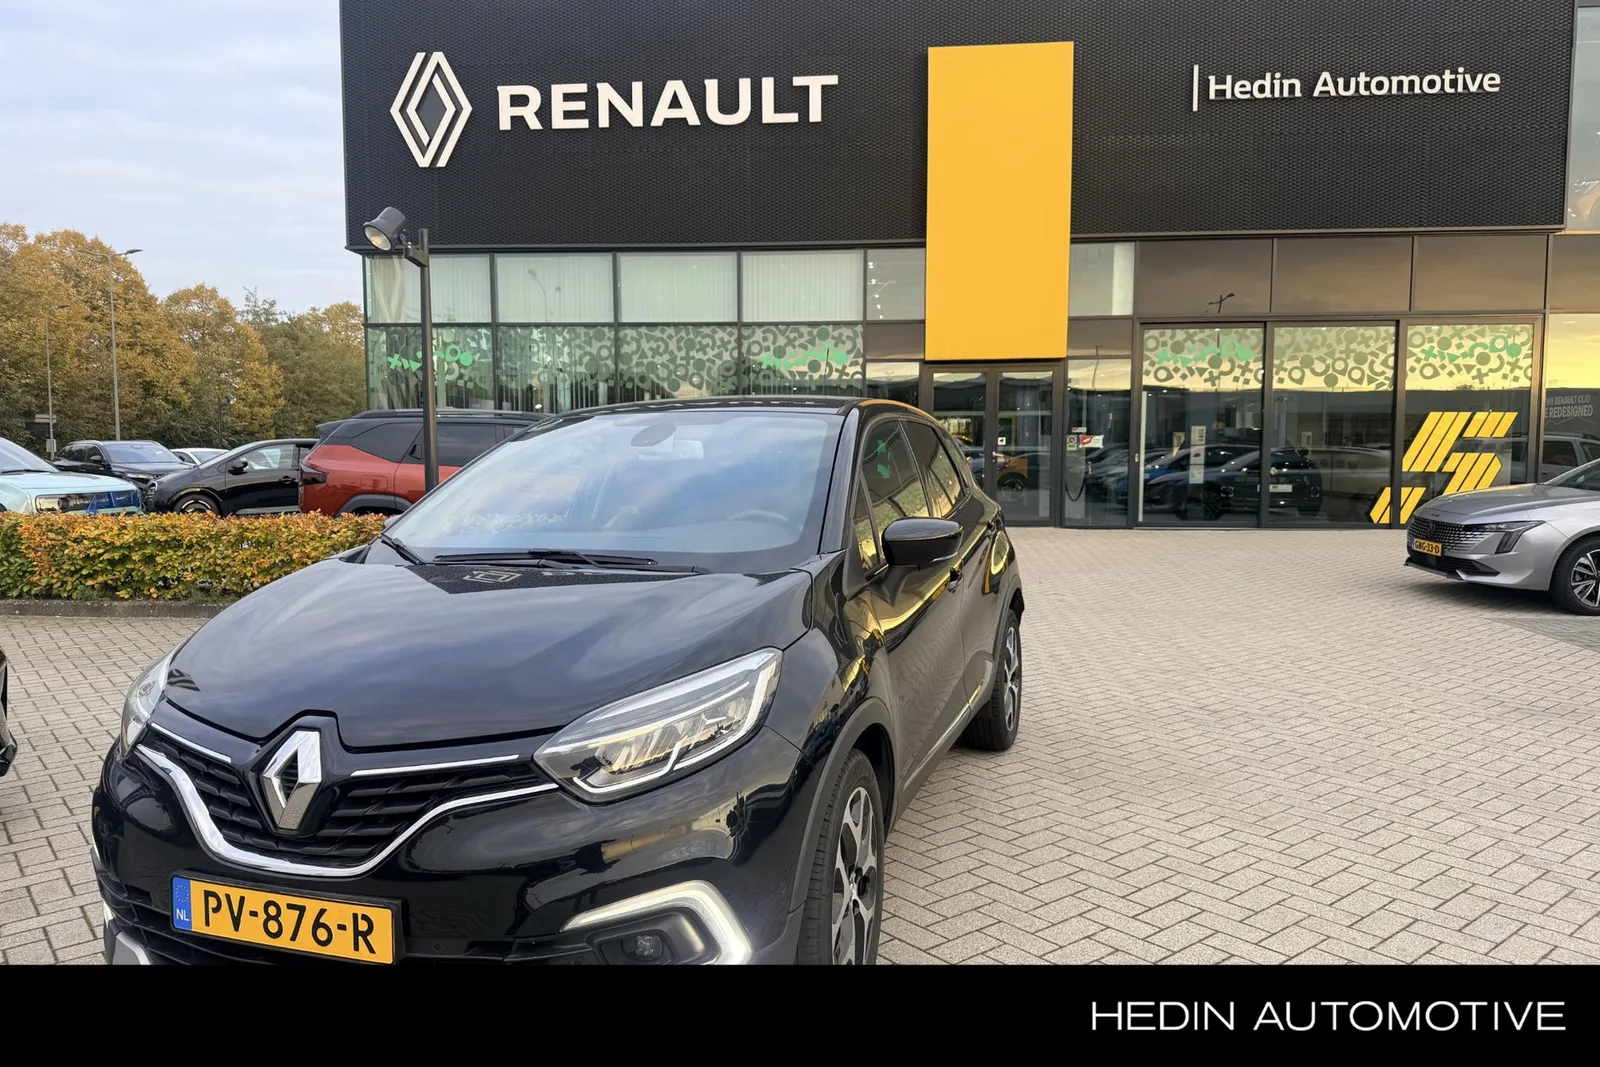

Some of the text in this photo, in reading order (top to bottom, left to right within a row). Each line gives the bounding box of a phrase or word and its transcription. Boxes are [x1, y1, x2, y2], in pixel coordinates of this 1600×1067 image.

[1208, 67, 1501, 100] Hedin Automotive
[496, 74, 839, 131] RENAULT
[1578, 393, 1591, 404] CLIO
[1549, 405, 1594, 418] REDESIGNED
[176, 908, 190, 922] NL
[203, 889, 376, 954] PV-876-R
